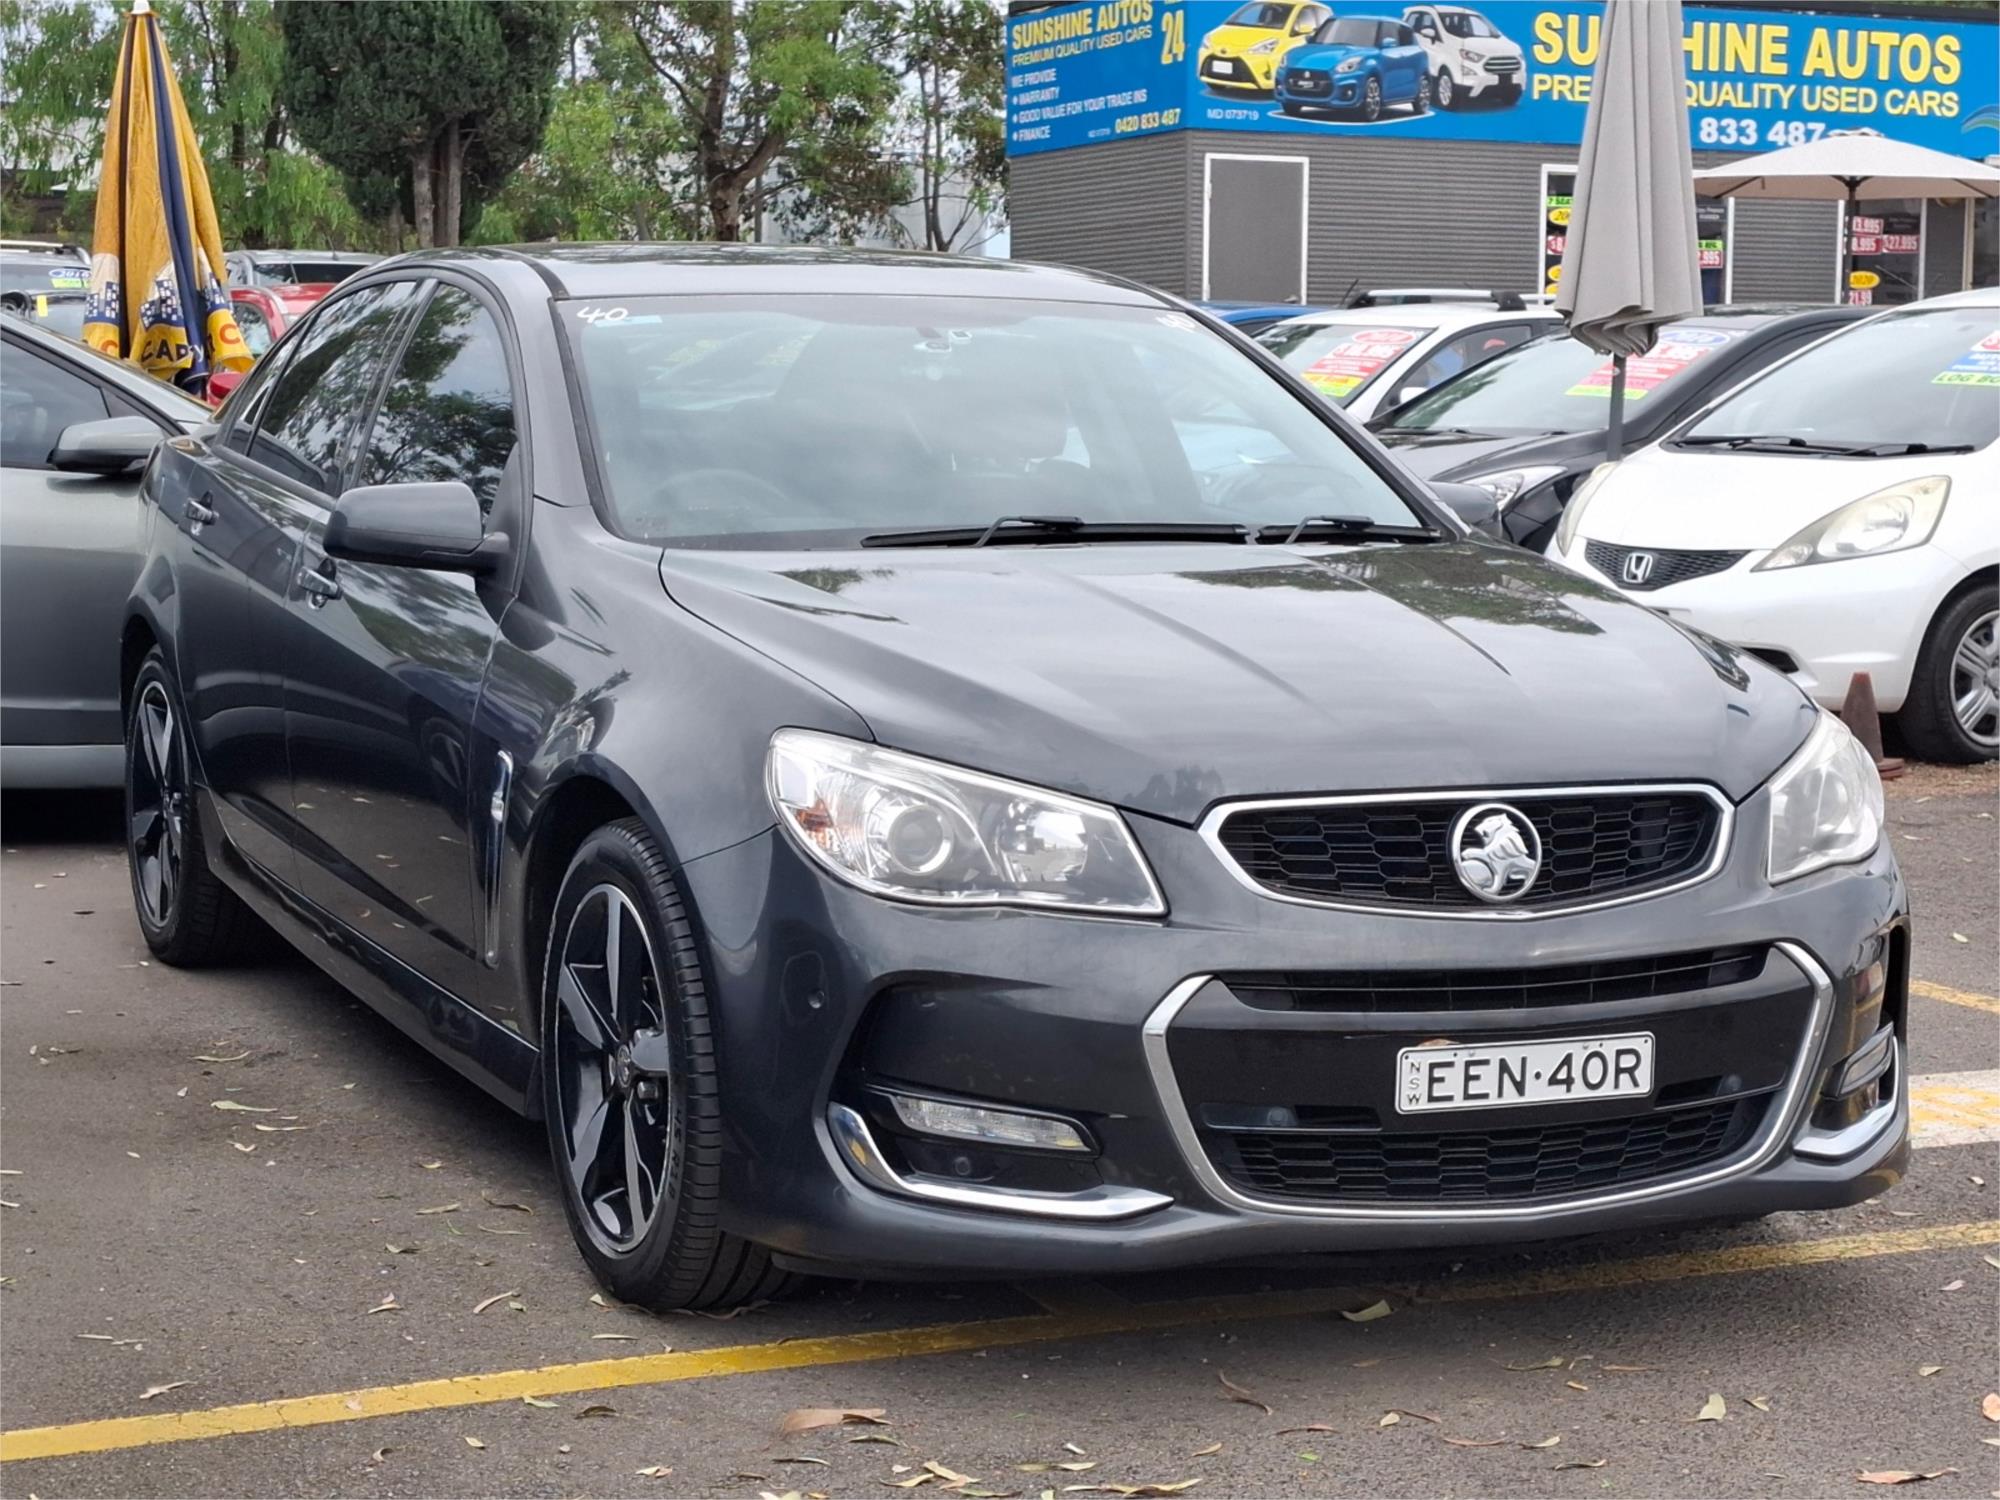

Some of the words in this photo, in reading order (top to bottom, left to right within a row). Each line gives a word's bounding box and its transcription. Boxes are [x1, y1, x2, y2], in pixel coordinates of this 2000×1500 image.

[1012, 8, 1093, 50] SUNSHINE
[1096, 0, 1153, 32] AUTOS
[1161, 10, 1184, 65] 24
[1012, 47, 1055, 68] PREMIUM
[1055, 38, 1095, 58] QUALITY
[1096, 31, 1123, 49] USED
[1125, 24, 1152, 43] CARS
[1533, 12, 1789, 76] SUHINE
[1801, 27, 1962, 84] AUTOS
[1024, 68, 1056, 86] PROVIDE
[1019, 86, 1060, 105] WARRANTY
[1019, 108, 1041, 124] GOOD
[1041, 103, 1067, 119] VALUE
[1066, 100, 1083, 115] FOR
[1083, 97, 1105, 112] YOUR
[1106, 91, 1132, 108] TRADE
[1685, 80, 1796, 109] QUALITY
[1802, 85, 1877, 113] USED
[1884, 89, 1959, 117] CARS
[1019, 125, 1051, 142] FINANCE
[1115, 115, 1139, 134] 0420
[1141, 111, 1159, 129] 833
[1161, 107, 1181, 126] 487
[1699, 117, 1758, 145] 833
[1767, 120, 1827, 146] 487
[577, 306, 628, 323] 40
